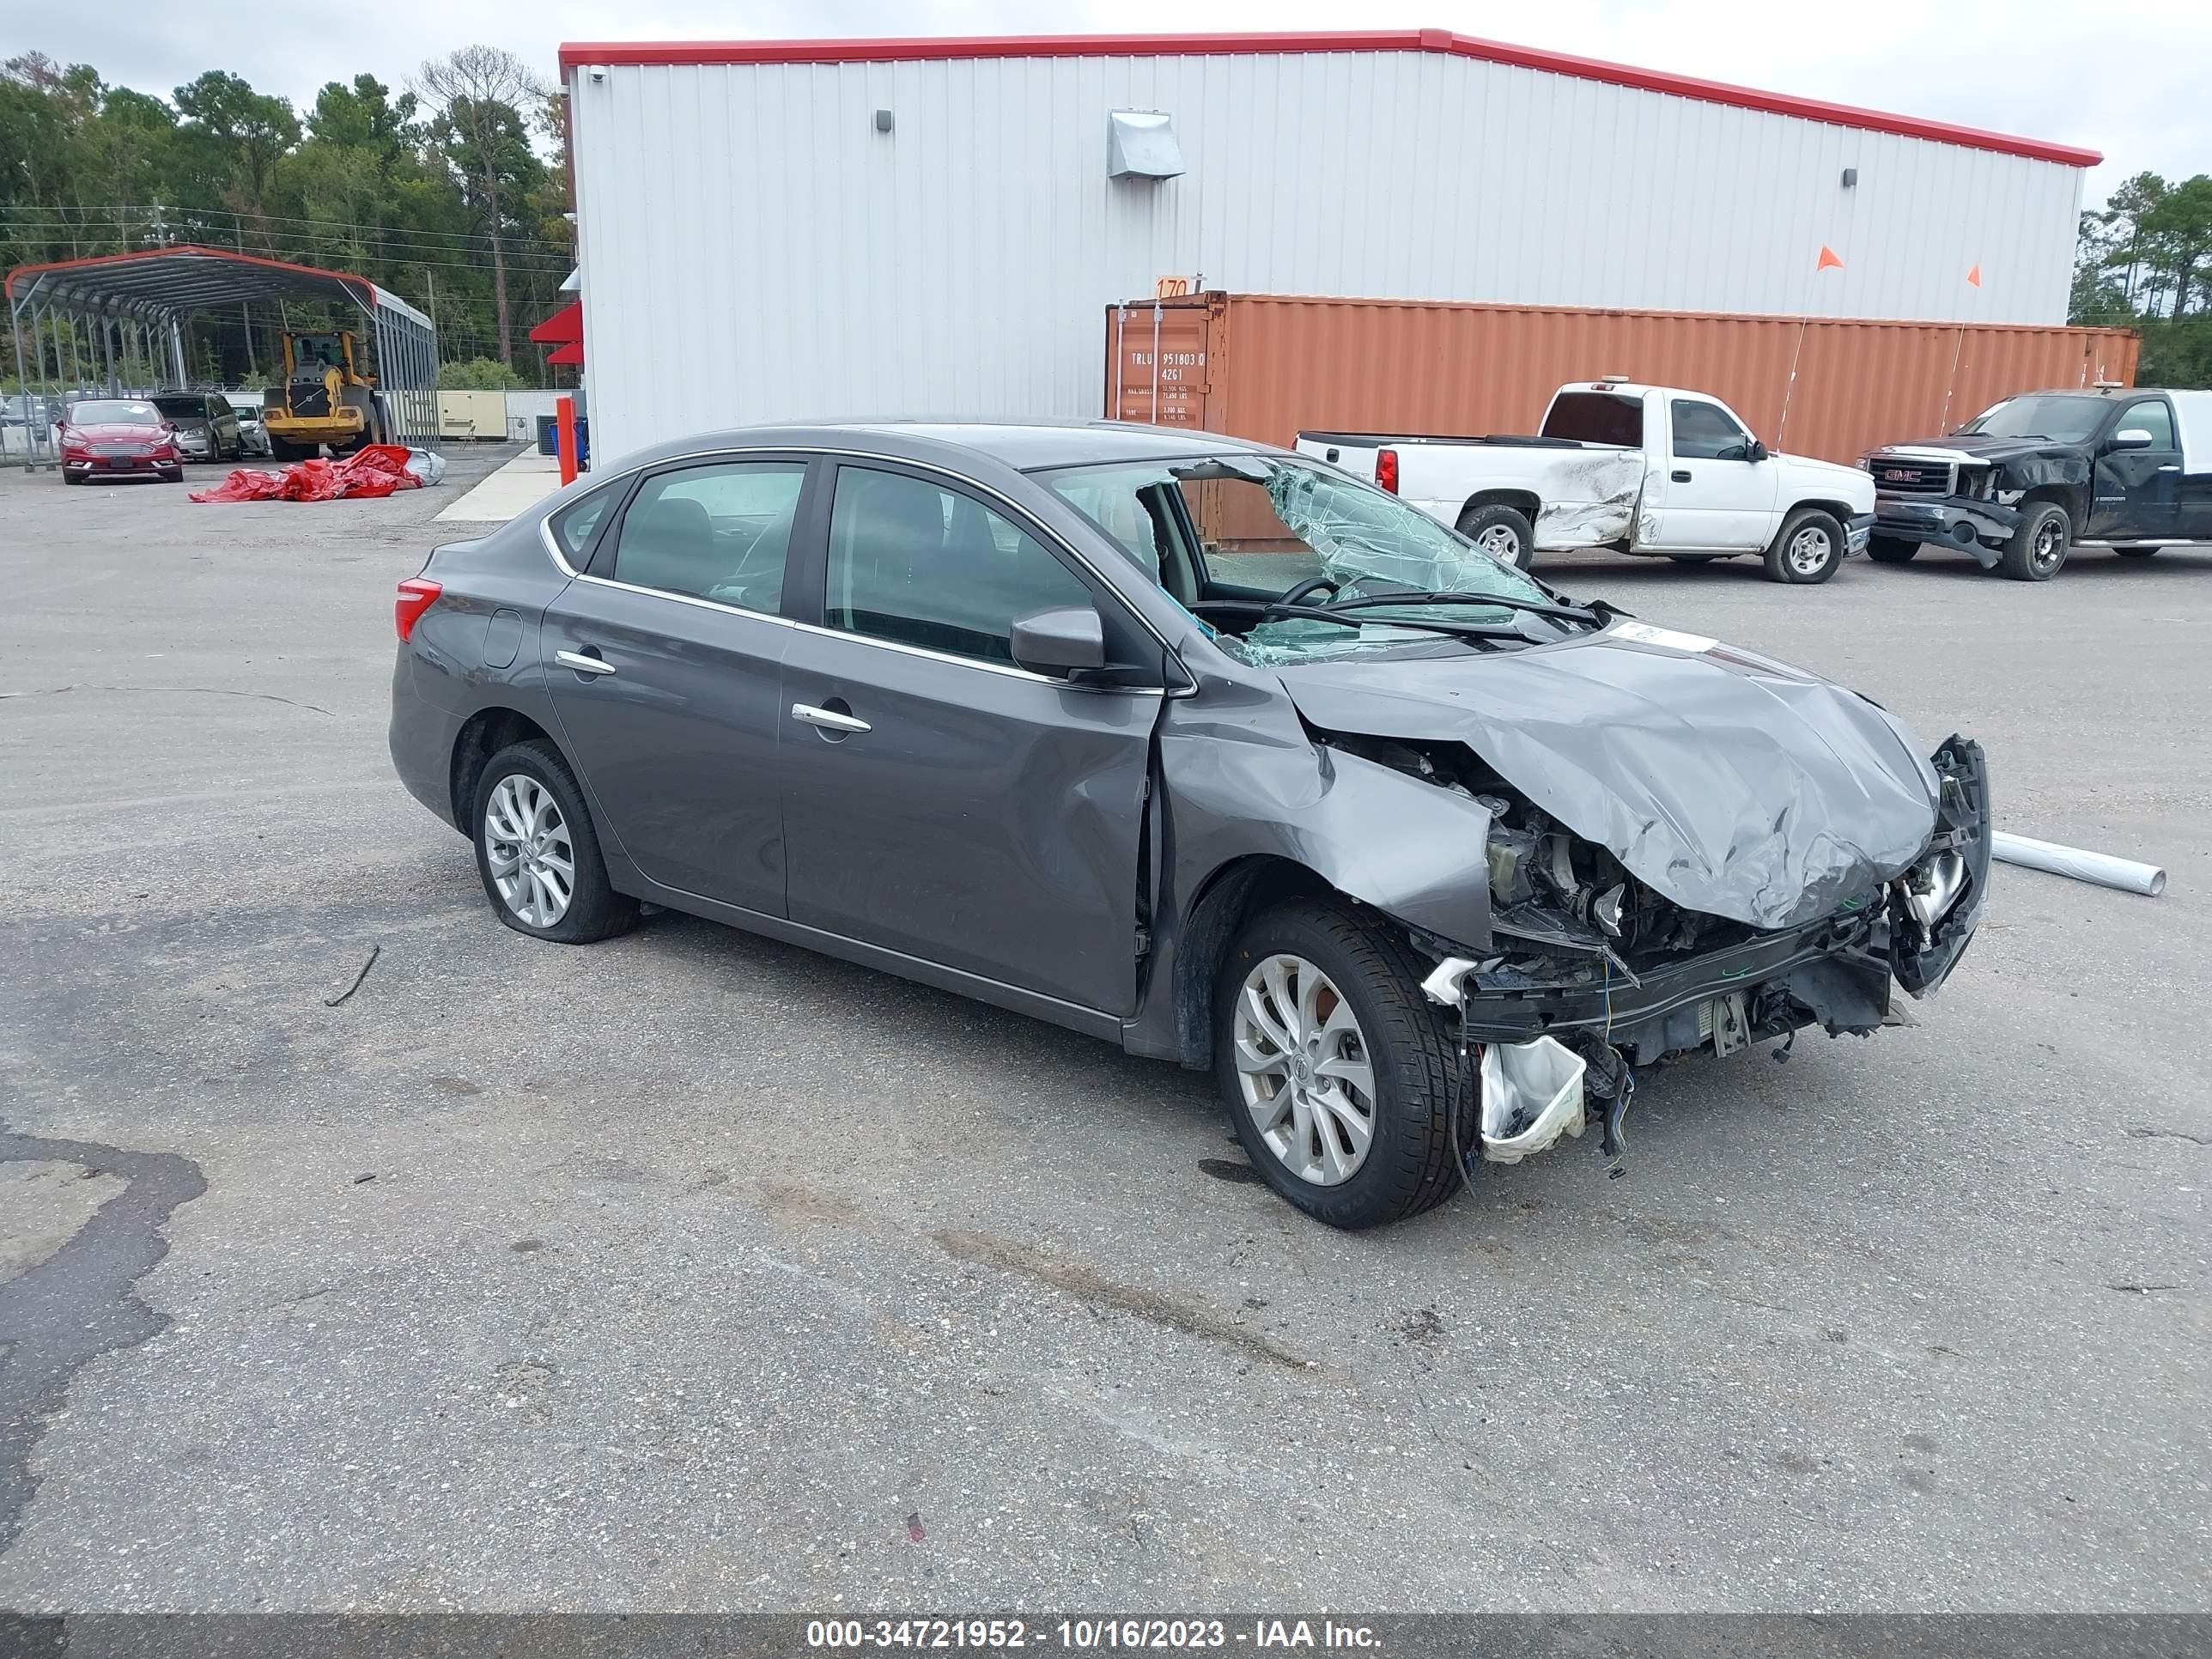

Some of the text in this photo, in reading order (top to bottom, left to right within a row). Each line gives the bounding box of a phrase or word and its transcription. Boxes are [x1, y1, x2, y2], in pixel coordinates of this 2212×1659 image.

[1157, 279, 1187, 300] 170
[1132, 353, 1152, 365] TRLU
[1163, 353, 1195, 366] 951803
[1162, 368, 1182, 380] 42G1
[1885, 469, 1922, 483] GMC
